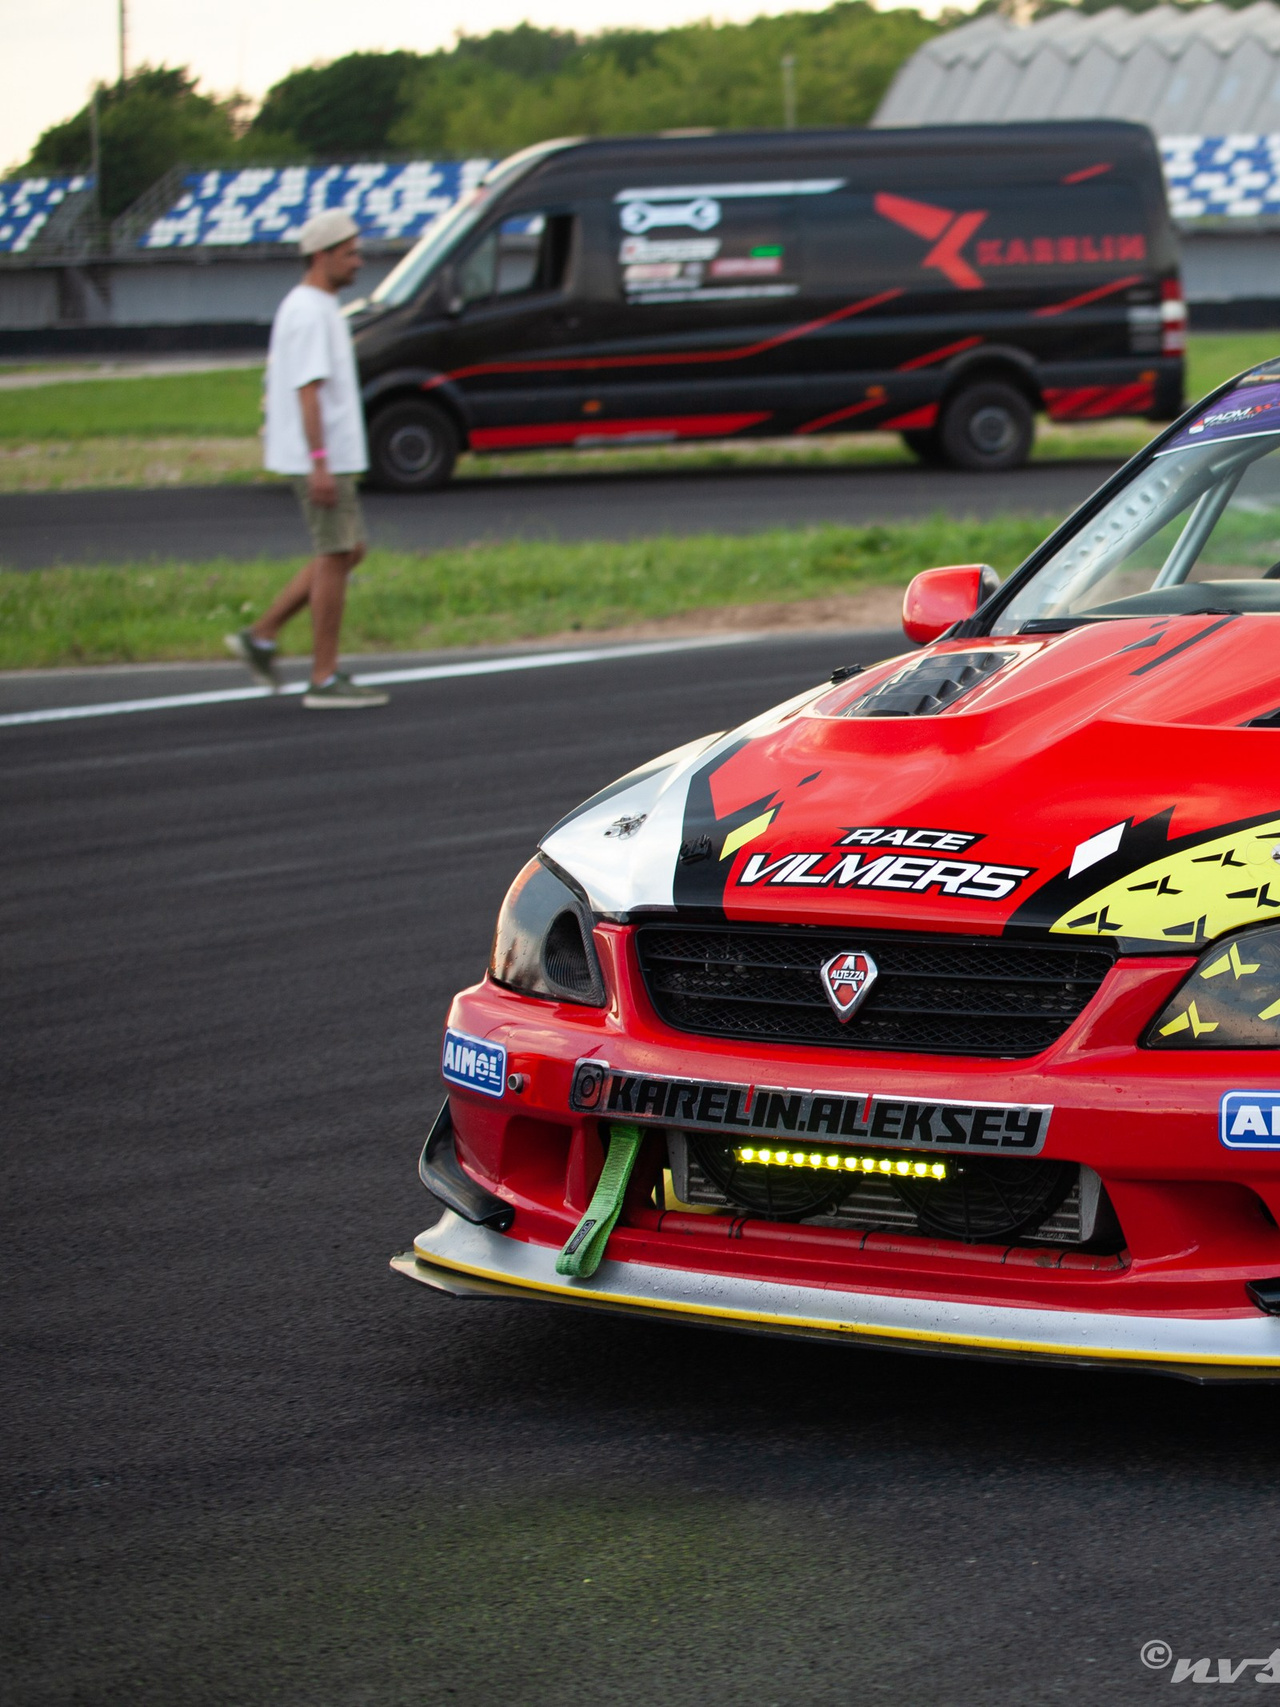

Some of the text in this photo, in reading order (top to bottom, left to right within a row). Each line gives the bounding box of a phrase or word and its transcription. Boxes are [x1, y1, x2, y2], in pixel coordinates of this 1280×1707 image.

[841, 827, 976, 852] RACE
[739, 853, 1031, 900] VILMERS
[830, 969, 865, 981] ALTEZZA
[607, 1073, 1044, 1147] KARELIN.ALEKSEY
